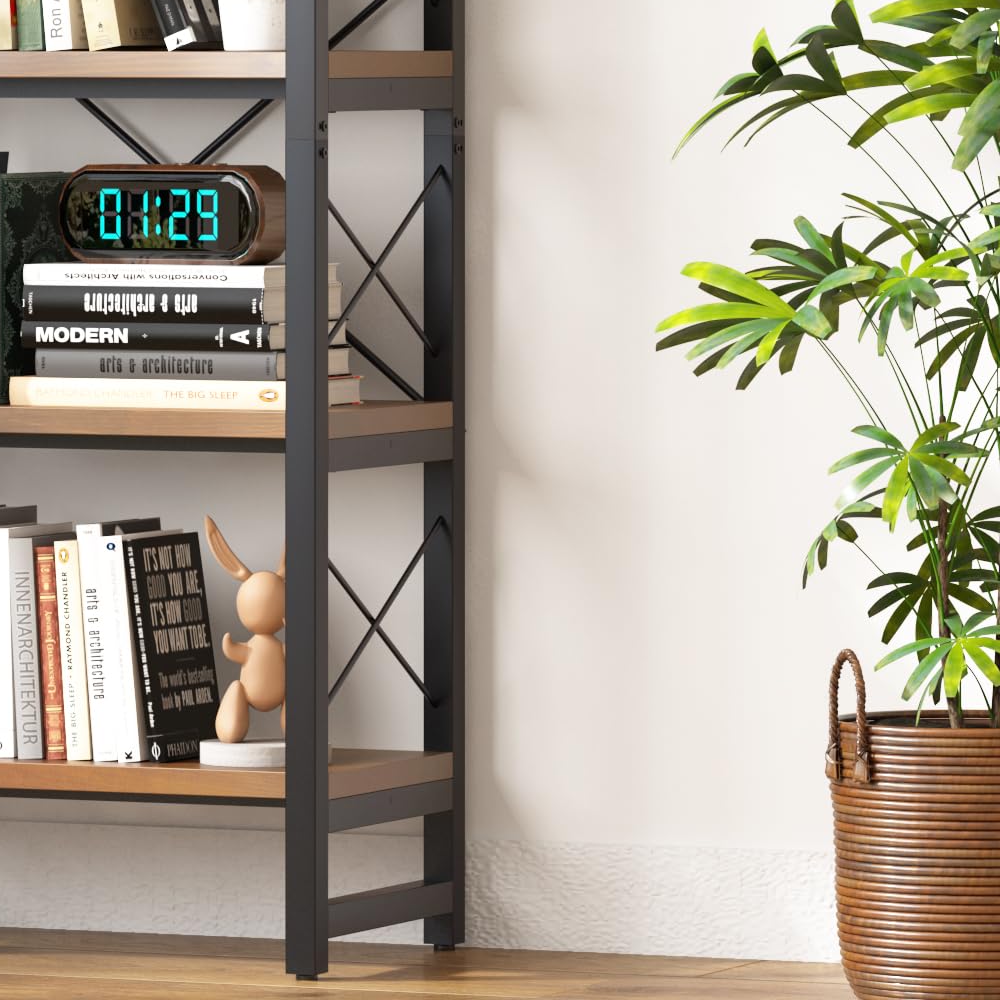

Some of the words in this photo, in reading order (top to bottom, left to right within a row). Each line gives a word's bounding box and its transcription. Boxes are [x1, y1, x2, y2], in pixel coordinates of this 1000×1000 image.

[50, 7, 63, 39] Ron
[99, 188, 219, 241] 01:29
[64, 272, 117, 281] Architects
[122, 272, 147, 281] with
[150, 272, 228, 282] Conversations
[83, 292, 155, 318] architecture
[174, 294, 198, 317] arts
[35, 327, 129, 344] MODERN
[99, 356, 122, 374] arts
[142, 357, 213, 375] architecture
[163, 390, 185, 400] THE
[187, 391, 206, 400] BIG
[208, 391, 239, 400] SLEEP
[142, 547, 159, 573] IT'S
[158, 545, 174, 571] NOT
[174, 544, 192, 569] HOW
[146, 574, 167, 600] GOOD
[167, 571, 184, 597] YOU
[185, 569, 203, 598] ARE,
[85, 588, 98, 610] arts
[149, 602, 166, 627] IT'S
[165, 600, 182, 625] HOW
[182, 597, 203, 622] GOOD
[43, 610, 56, 645] JOURNEY
[153, 628, 170, 655] YOU
[167, 626, 189, 653] WANT
[188, 624, 199, 649] TO
[198, 623, 211, 649] BE.
[15, 571, 38, 746] INNENARCHITEKTUR
[65, 622, 73, 671] RAYMOND
[89, 630, 105, 700] architecture
[158, 671, 169, 689] The
[173, 691, 182, 712] by
[181, 688, 195, 707] PAUL
[166, 740, 199, 757] PHAIDON
